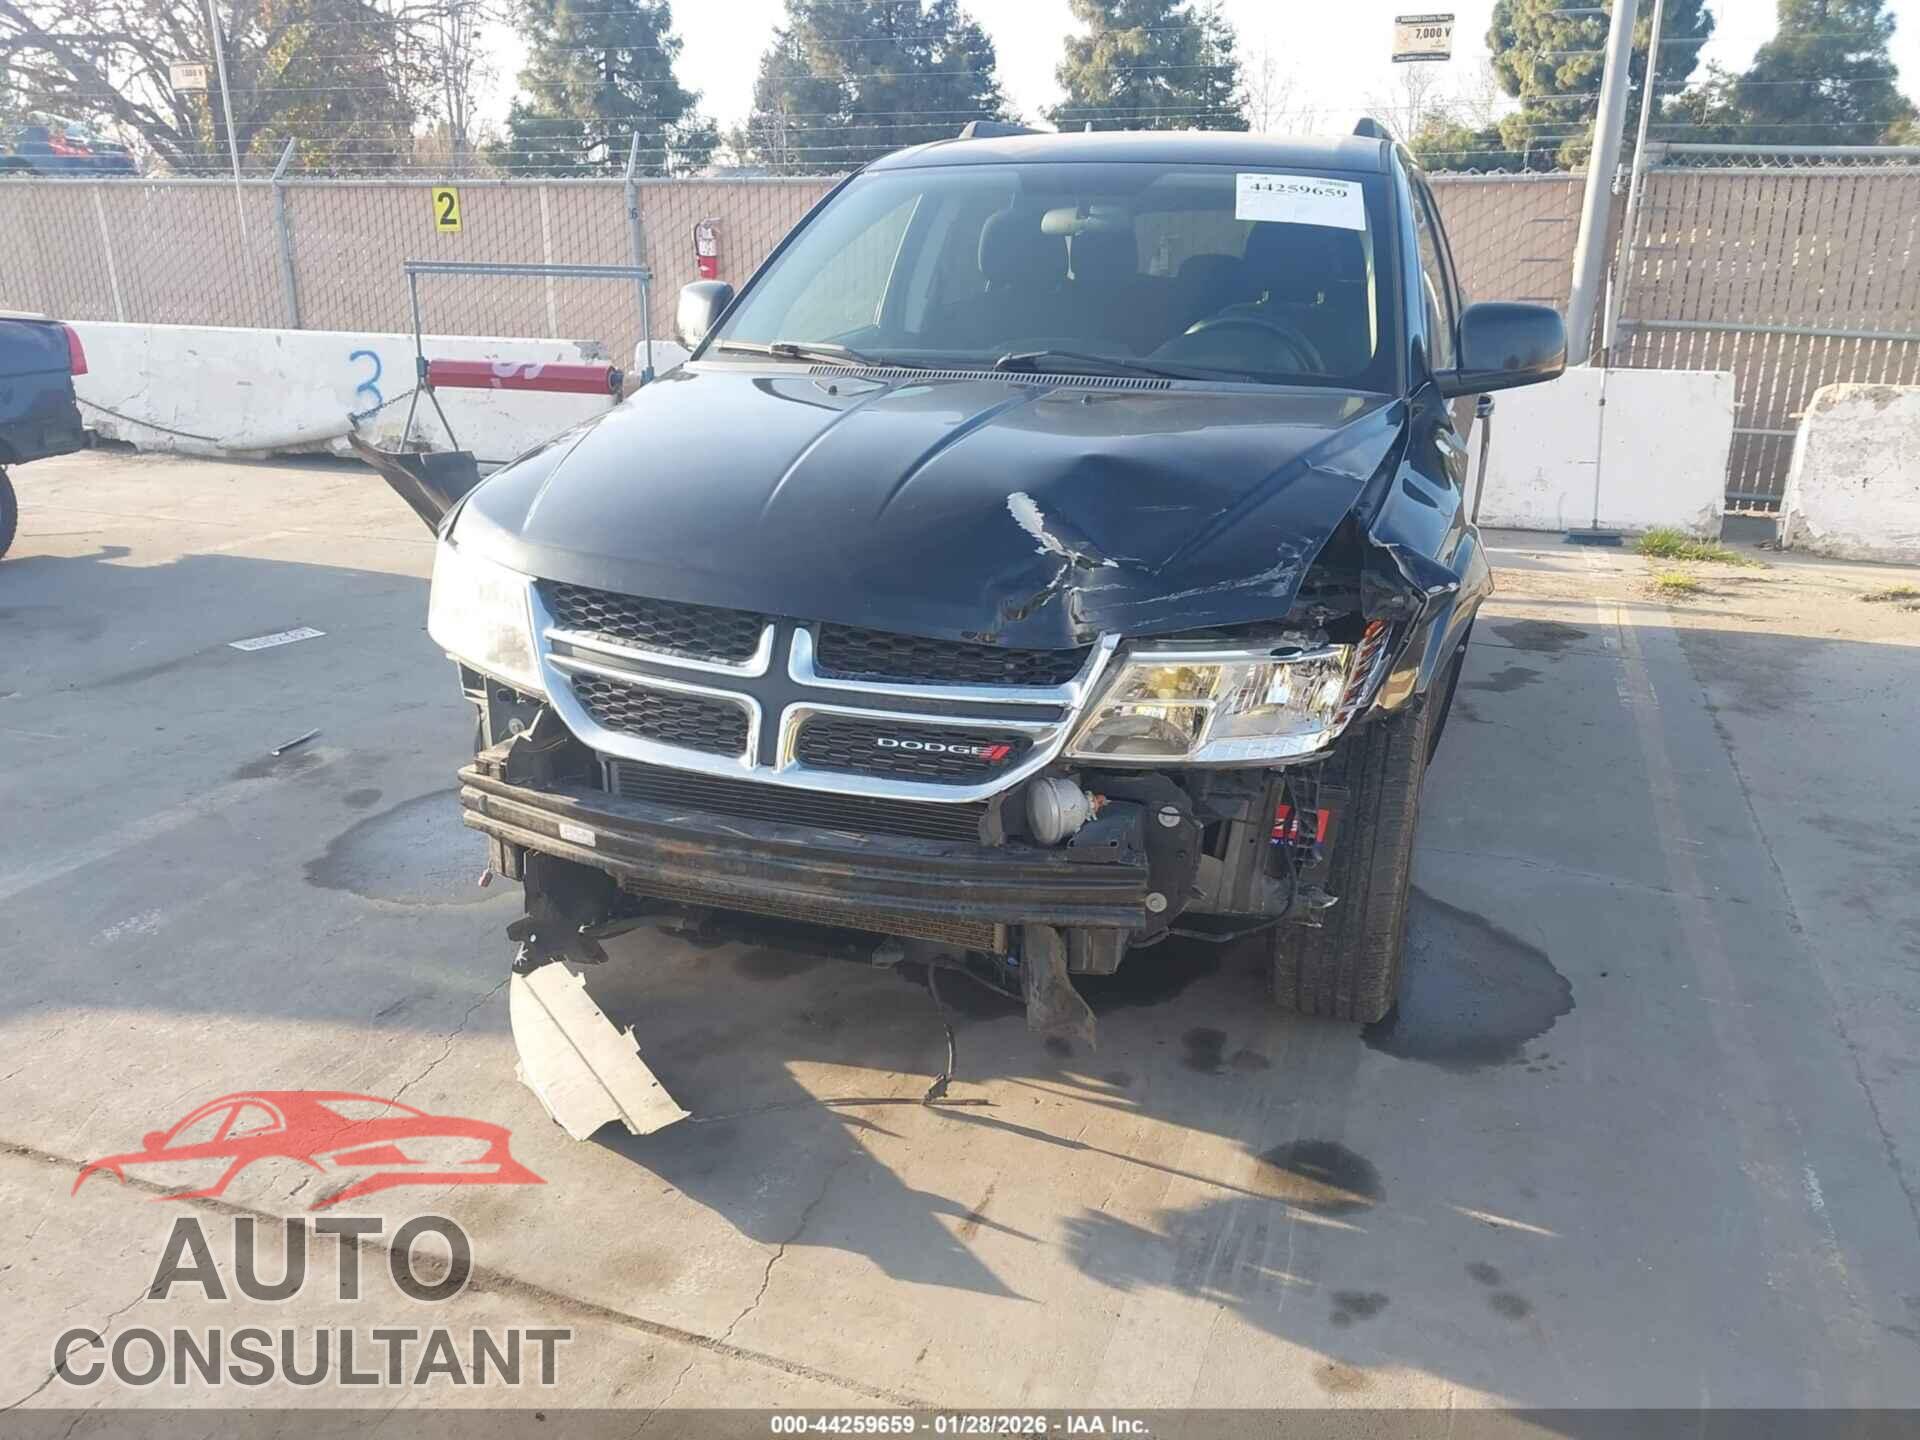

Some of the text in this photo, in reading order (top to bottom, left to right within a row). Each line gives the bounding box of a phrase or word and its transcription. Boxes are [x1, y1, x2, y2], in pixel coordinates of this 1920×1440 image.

[1415, 26, 1452, 40] 7,000 V
[1249, 183, 1348, 198] 44259659
[437, 191, 458, 225] 2
[350, 350, 383, 418] 3
[877, 737, 992, 758] DODGE
